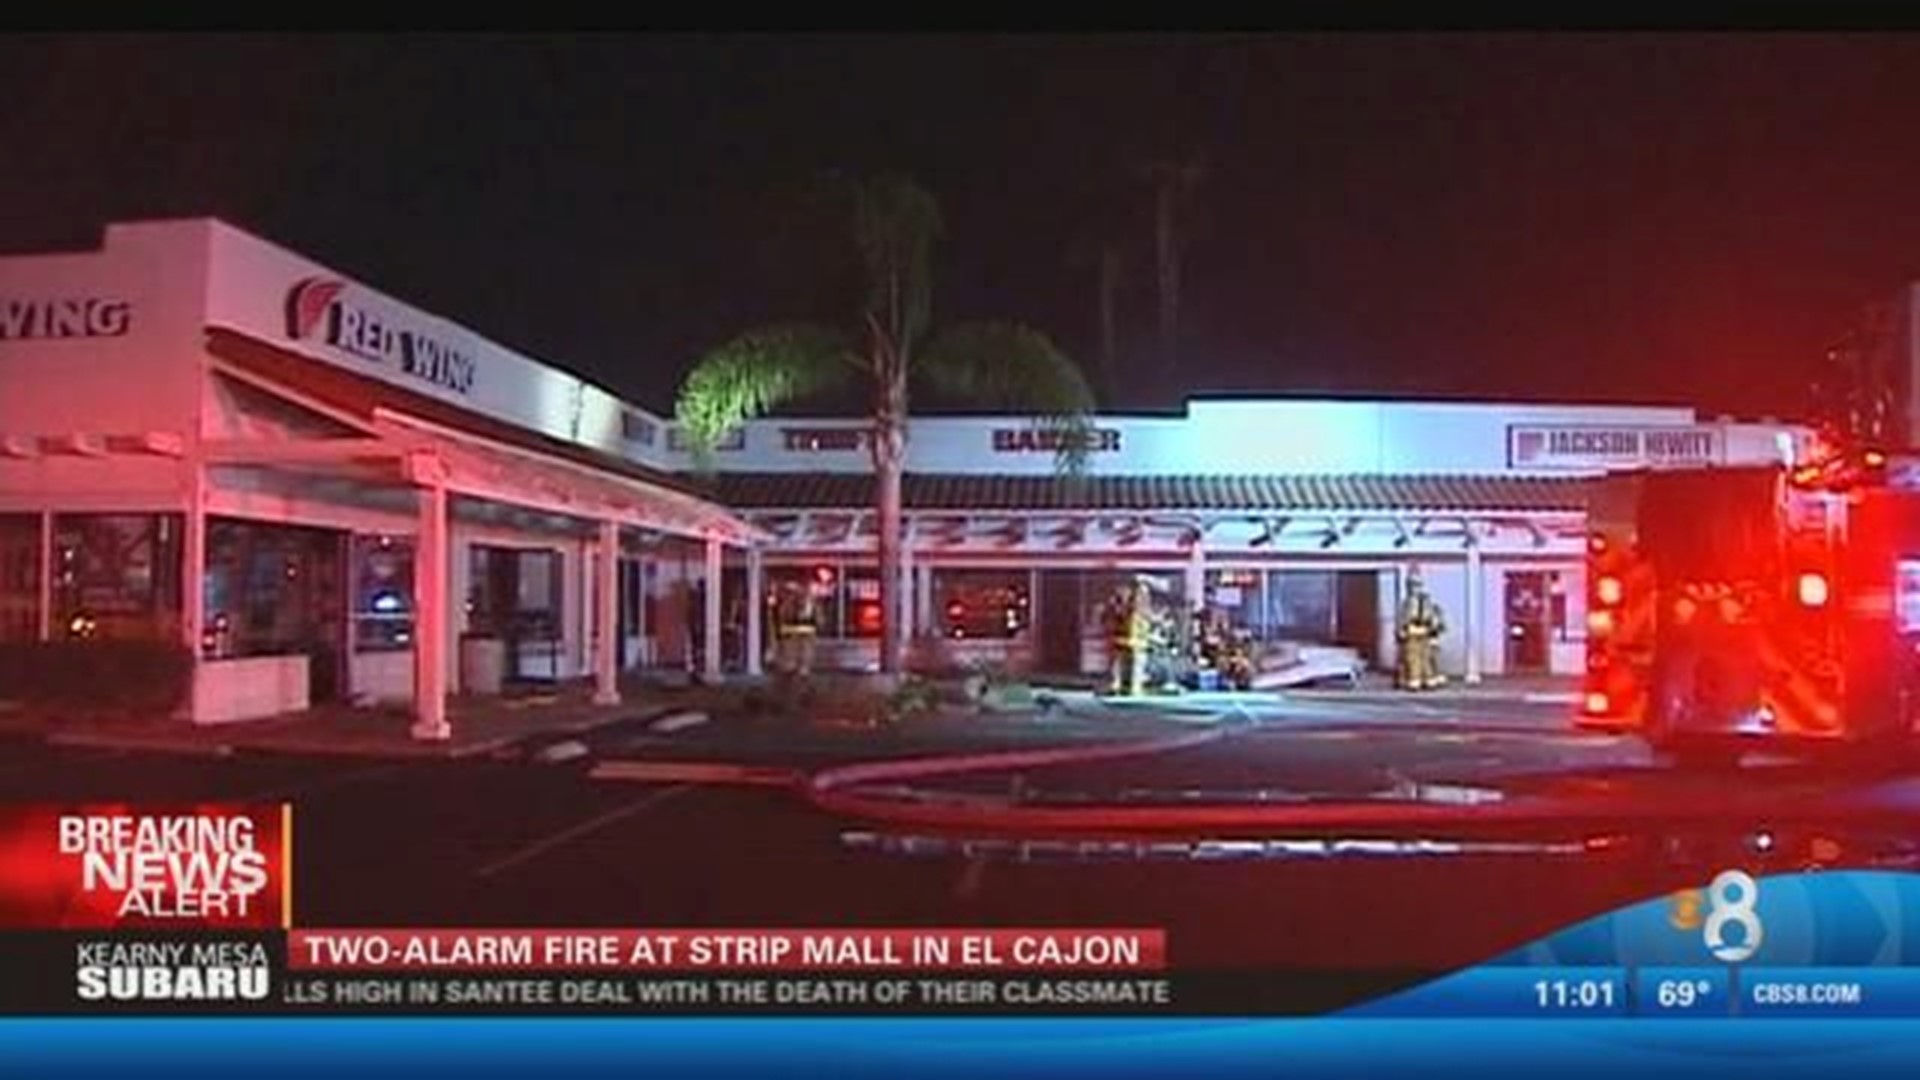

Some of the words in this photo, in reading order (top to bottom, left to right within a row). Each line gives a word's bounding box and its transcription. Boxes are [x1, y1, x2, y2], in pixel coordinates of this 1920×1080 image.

[334, 301, 394, 360] RED
[1549, 430, 1639, 456] JACKSON
[1645, 431, 1713, 457] HEWITT
